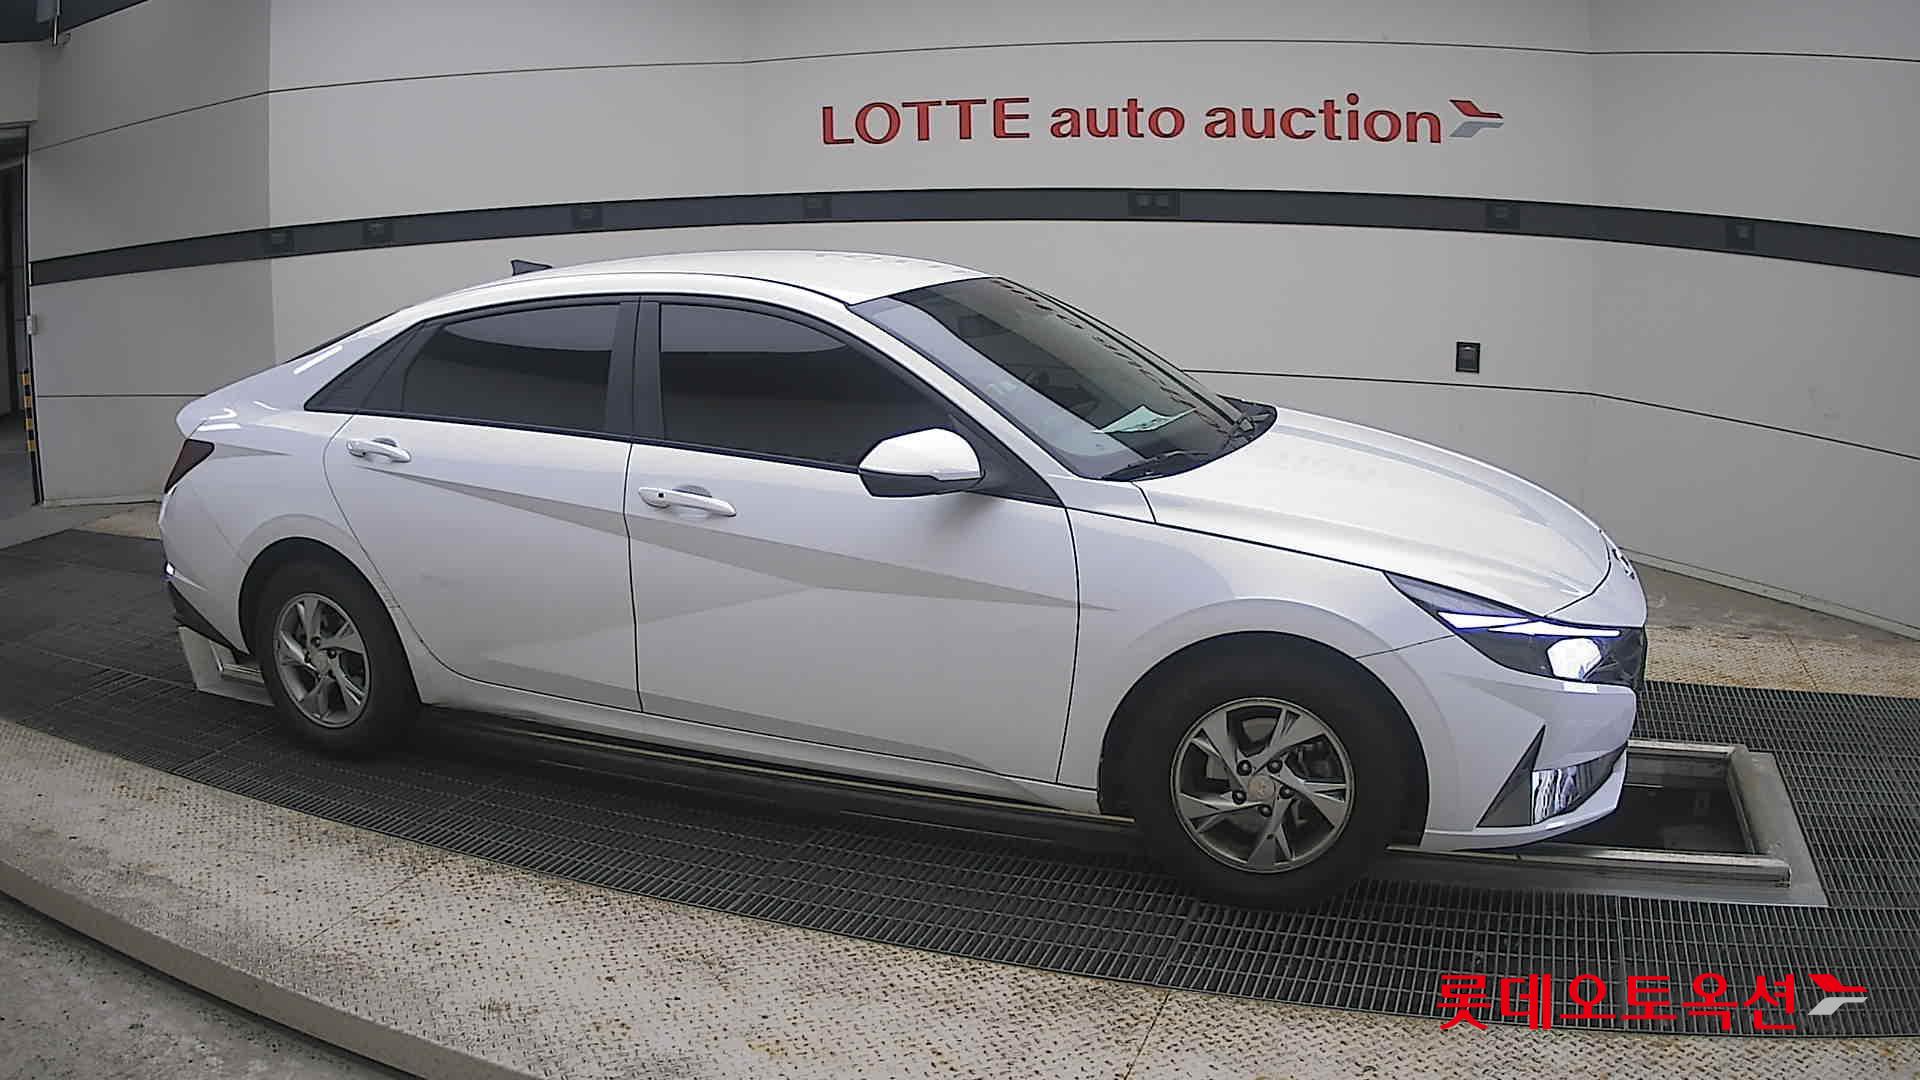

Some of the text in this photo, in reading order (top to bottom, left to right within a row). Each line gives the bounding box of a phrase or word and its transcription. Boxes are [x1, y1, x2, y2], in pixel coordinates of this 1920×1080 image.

[822, 93, 1442, 145] LOTTE auto auction
